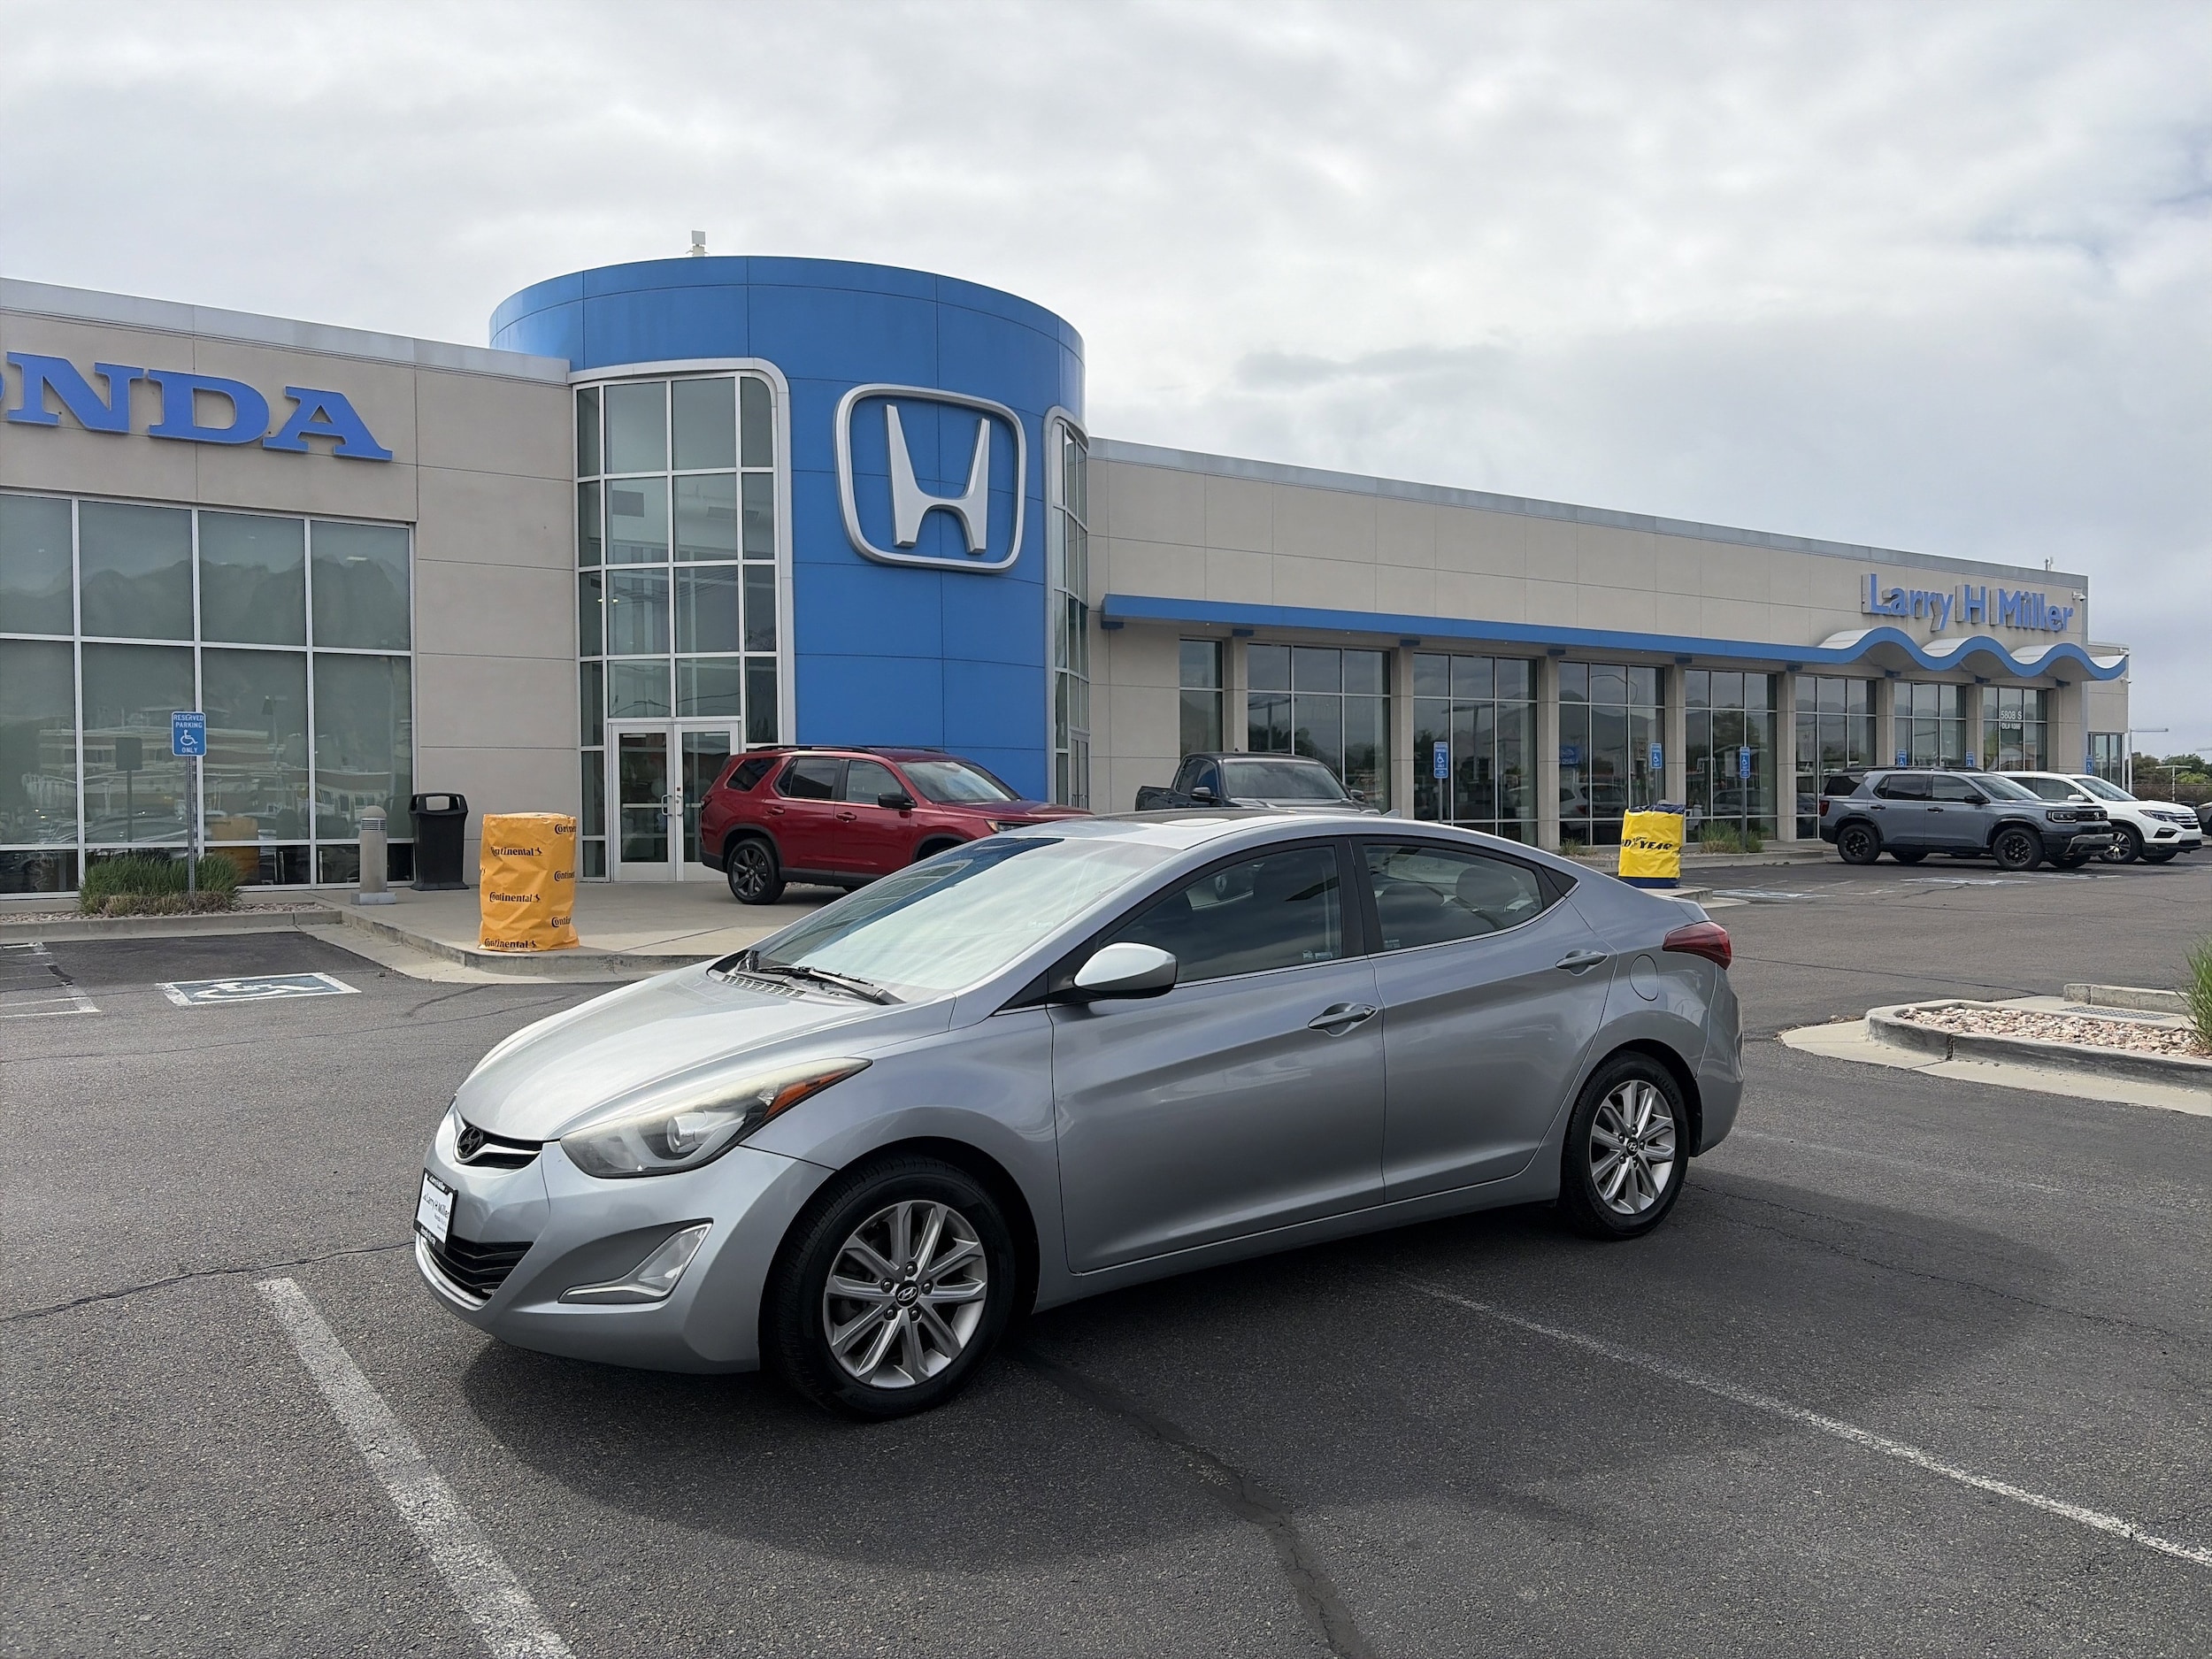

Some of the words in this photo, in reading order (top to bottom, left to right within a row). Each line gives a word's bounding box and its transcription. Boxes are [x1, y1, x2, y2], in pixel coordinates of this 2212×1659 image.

[0, 351, 393, 461] NDA
[1869, 573, 1954, 631] Larry
[1962, 584, 1986, 623] H
[1998, 588, 2074, 632] Miller
[489, 892, 533, 902] Continental
